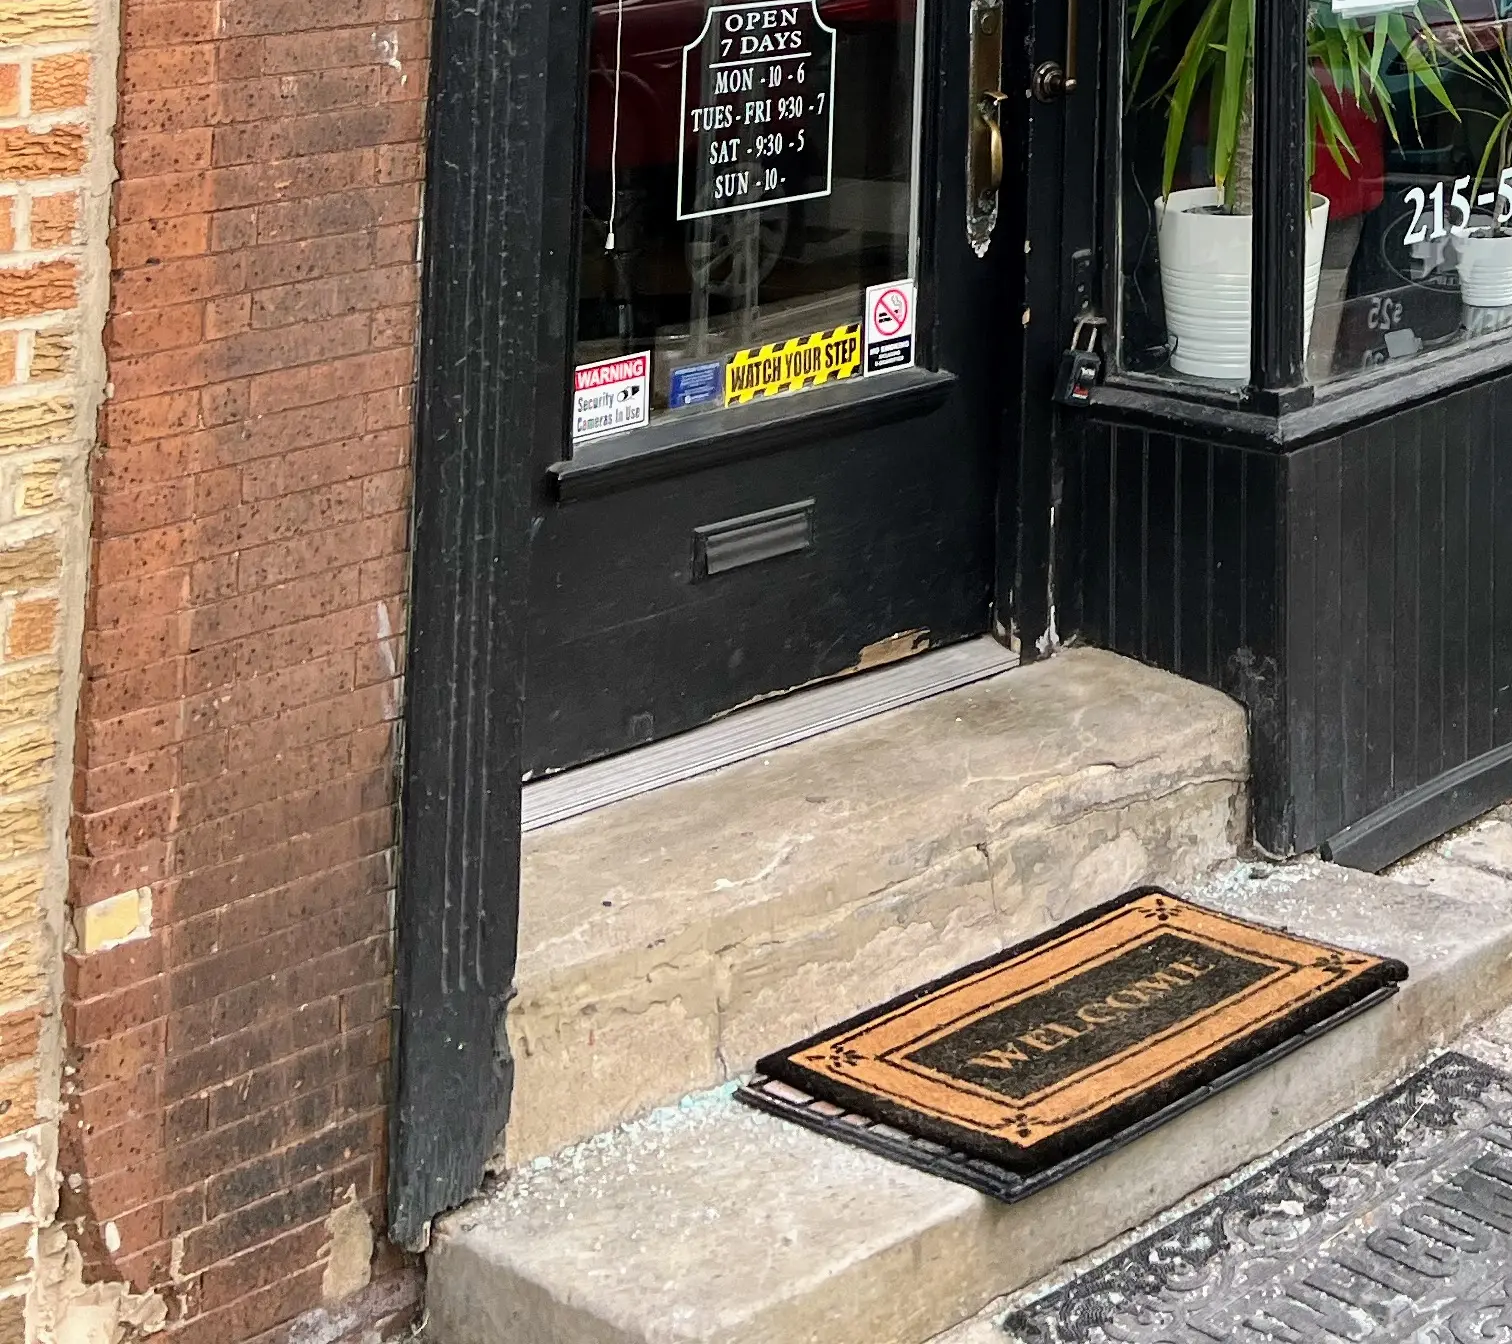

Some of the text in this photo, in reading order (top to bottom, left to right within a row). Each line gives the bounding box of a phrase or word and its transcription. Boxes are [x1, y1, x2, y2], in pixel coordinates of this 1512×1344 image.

[724, 7, 800, 33] OPEN
[720, 30, 803, 57] 7 DAYS
[713, 67, 755, 95] MON
[709, 138, 741, 165] SAT
[714, 171, 749, 200] SUN
[576, 358, 645, 389] WARNING
[731, 355, 782, 393] WATCH
[785, 346, 821, 379] YOUR
[825, 337, 857, 369] STEP
[577, 391, 615, 413] Security
[577, 411, 613, 433] Cameras
[625, 405, 641, 422] Use
[966, 956, 1216, 1071] WELCOME
